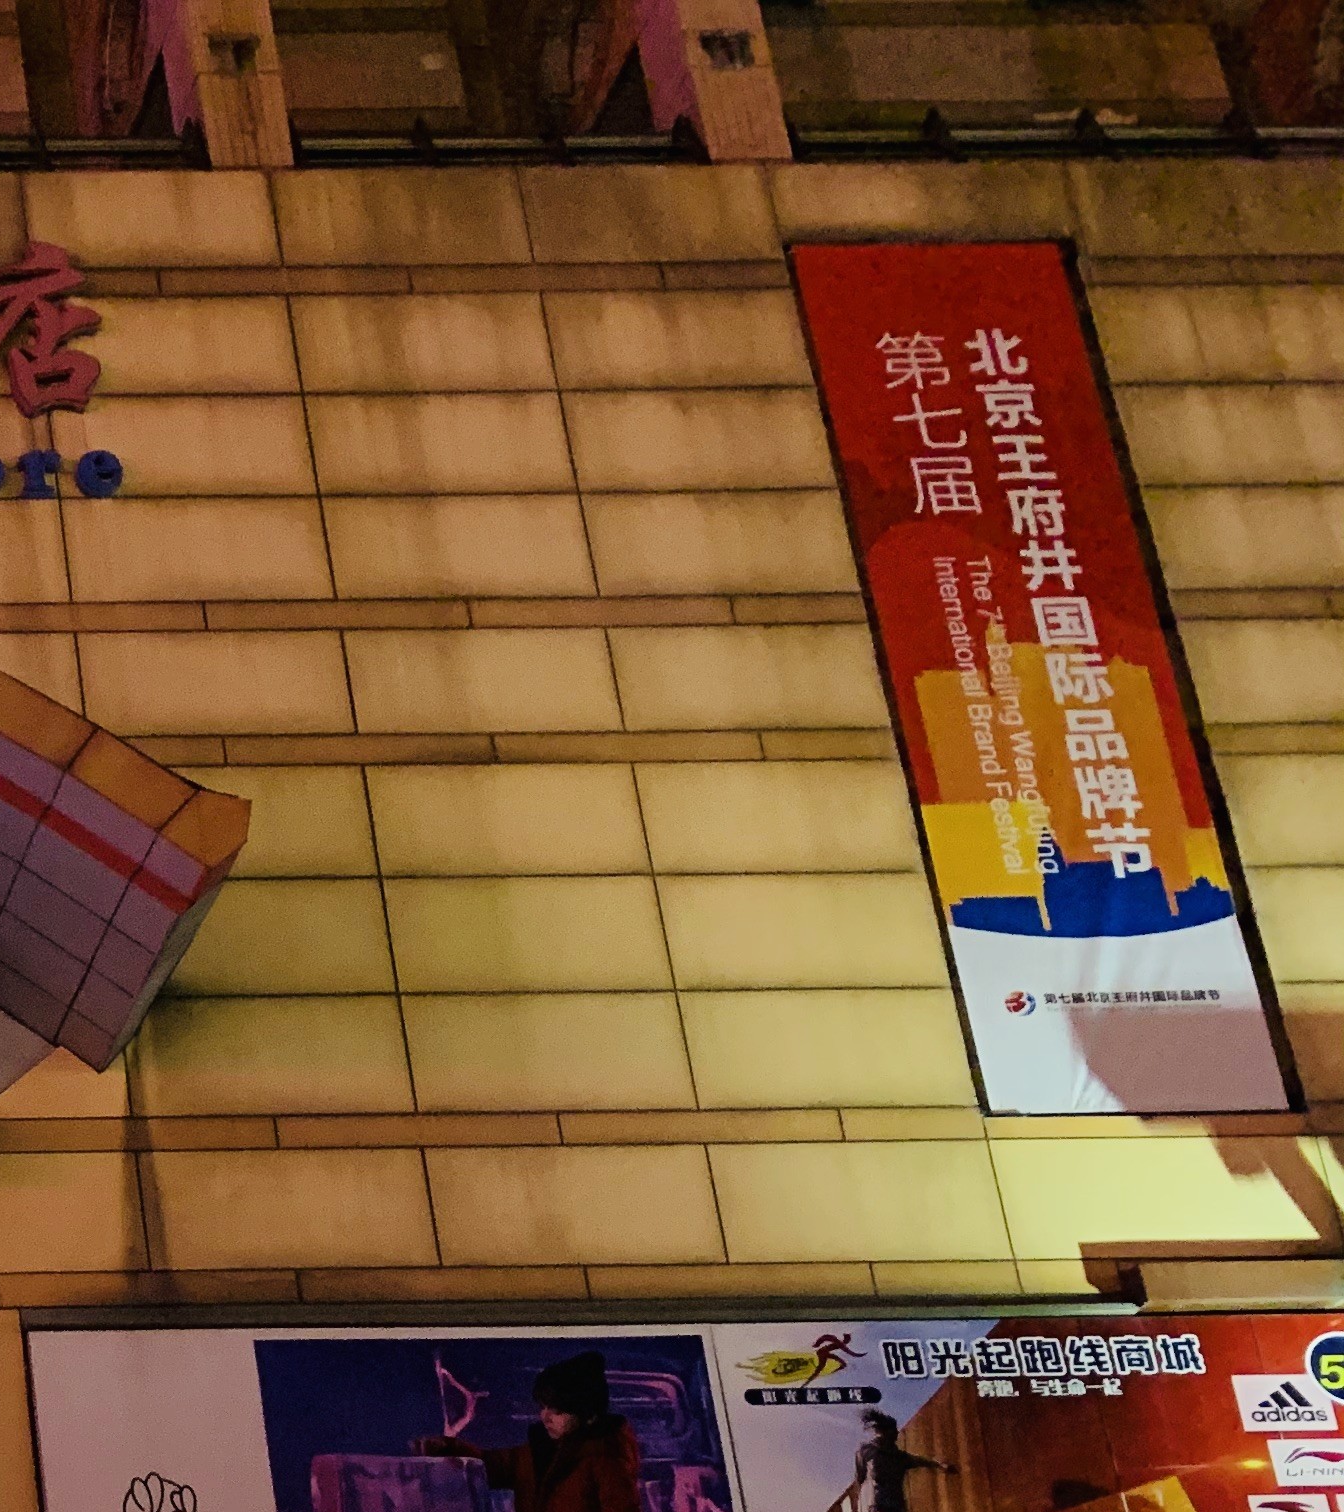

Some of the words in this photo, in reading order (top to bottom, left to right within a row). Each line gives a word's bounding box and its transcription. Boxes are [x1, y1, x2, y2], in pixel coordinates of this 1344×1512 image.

[875, 330, 983, 517] 第七届
[932, 556, 989, 698] International
[964, 327, 1154, 879] 北京王府井国际品牌节
[966, 554, 993, 602] The
[986, 643, 1024, 726] Beijing
[1009, 730, 1060, 875] Wangfujing
[967, 703, 1008, 776] Brand
[985, 781, 1031, 875] Festival
[880, 1334, 1207, 1379] 阳光起跑线商城
[1251, 1407, 1329, 1423] adidas
